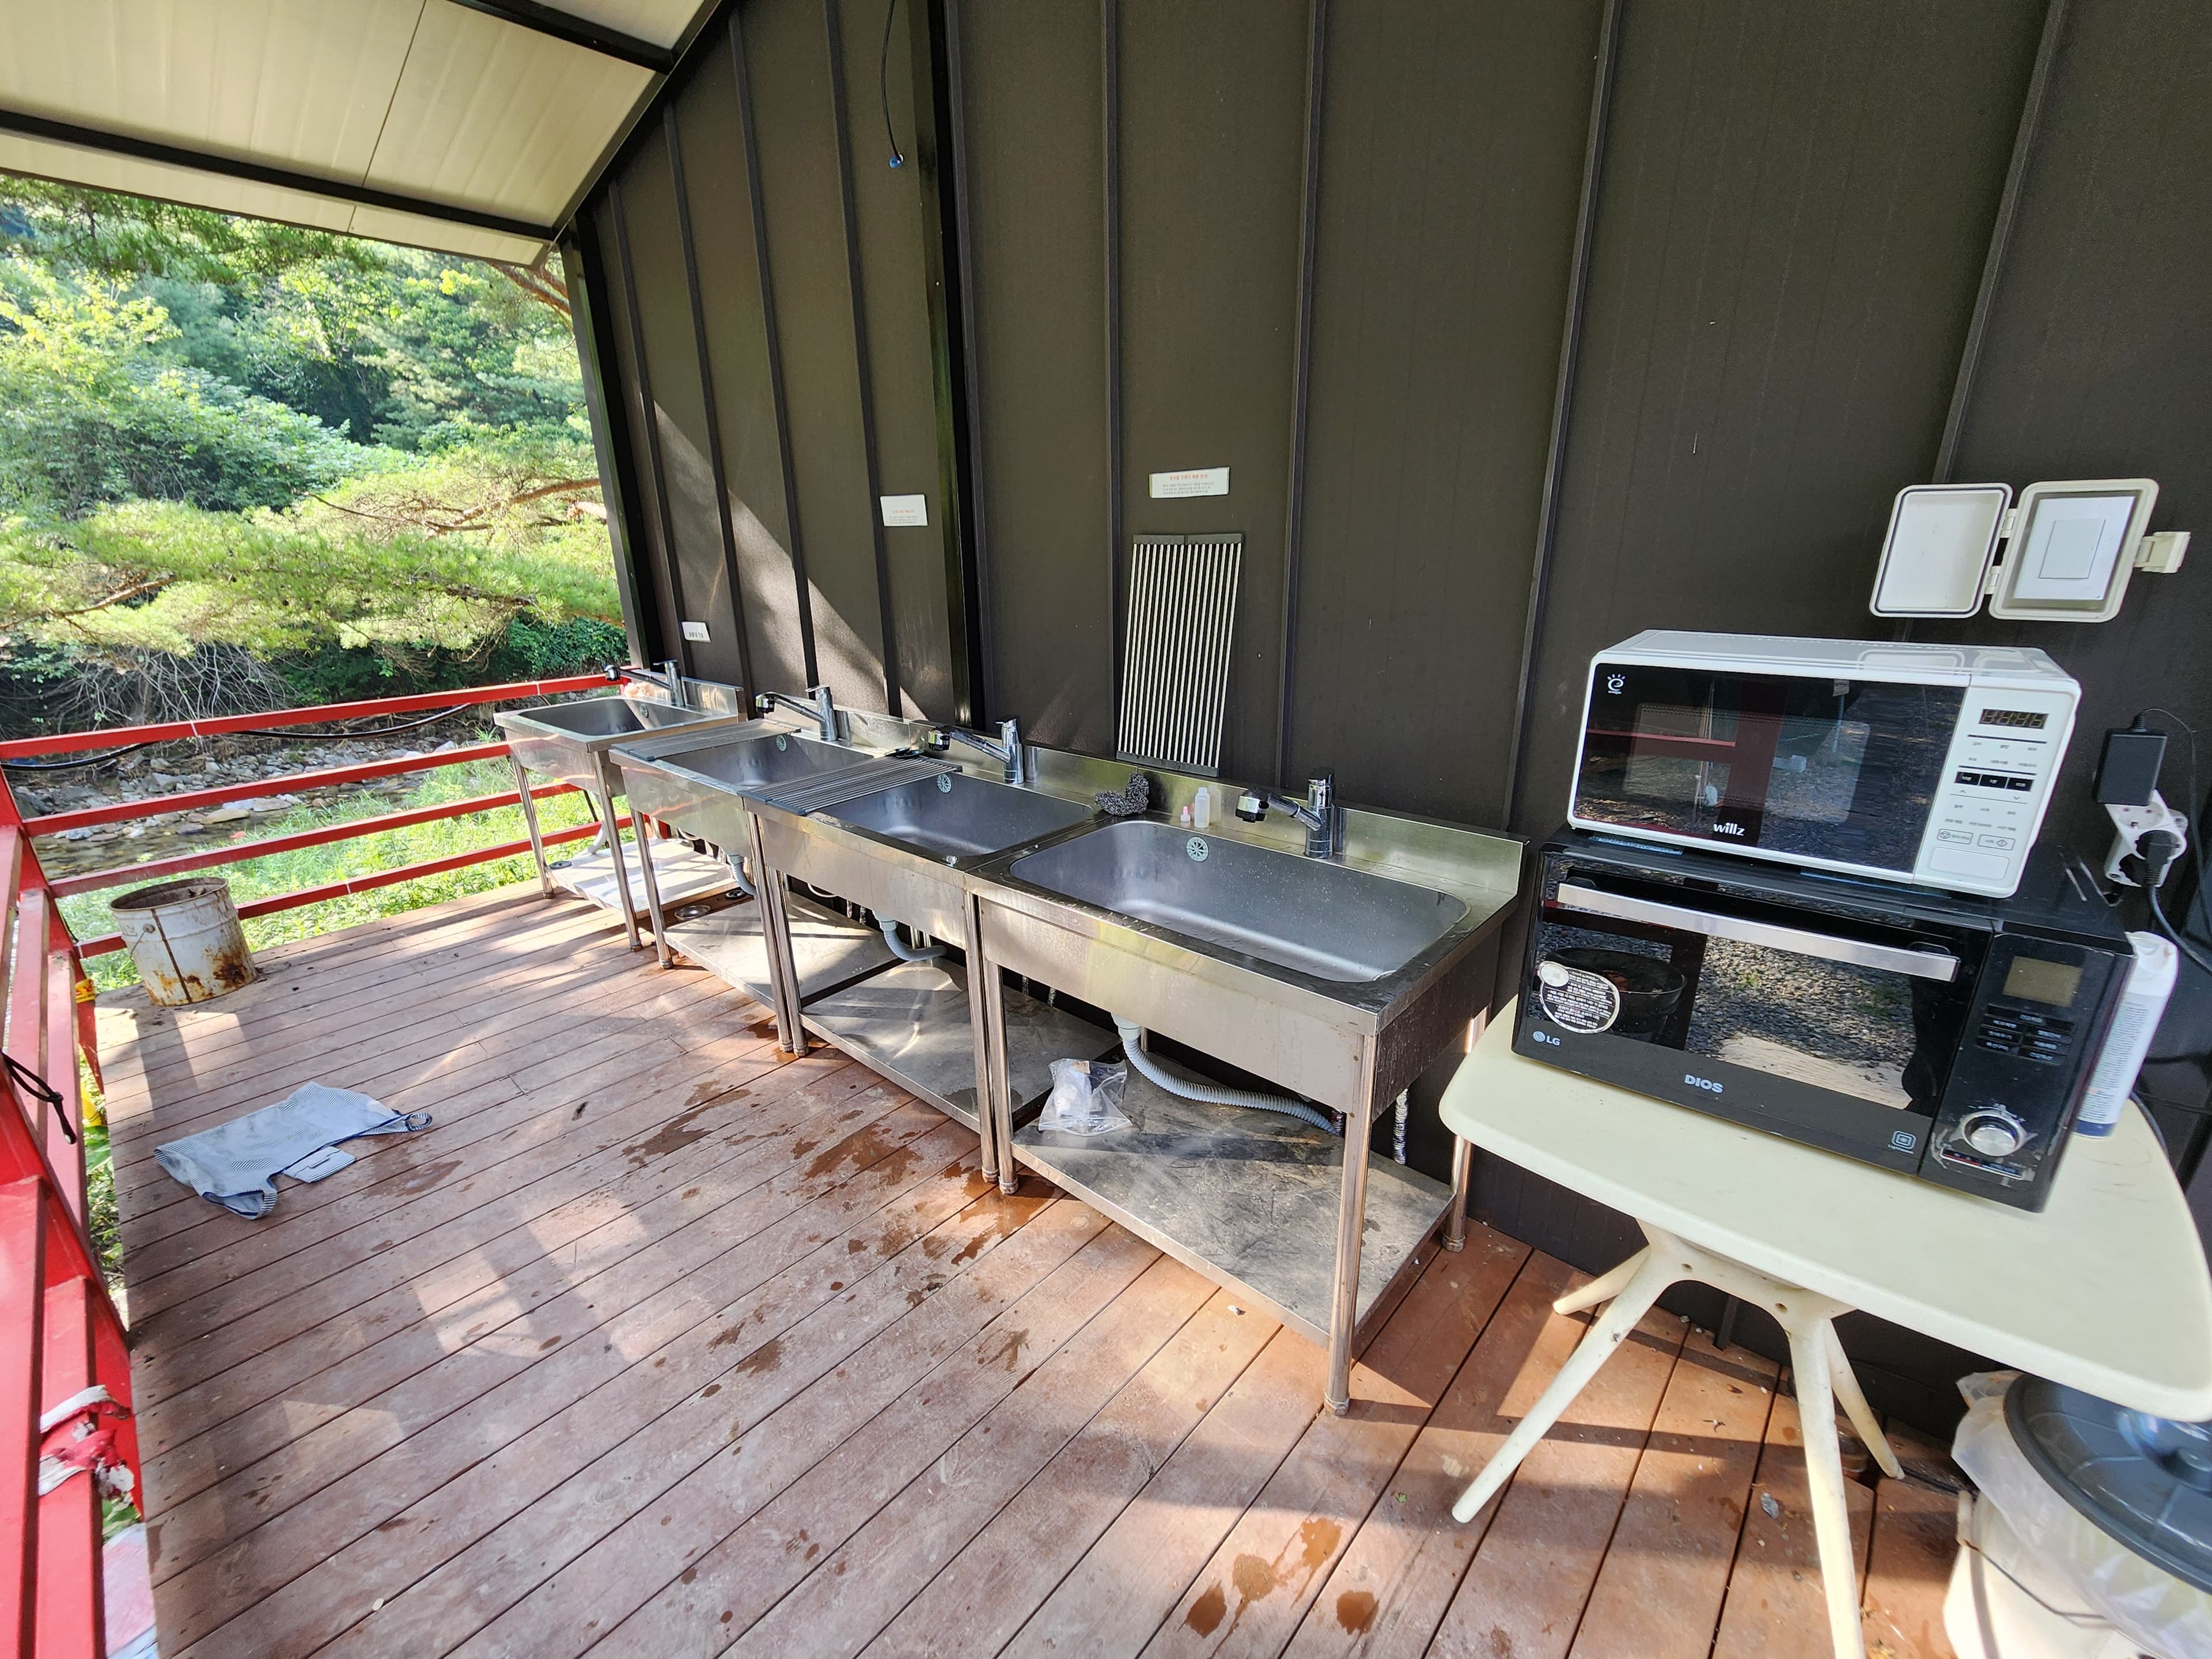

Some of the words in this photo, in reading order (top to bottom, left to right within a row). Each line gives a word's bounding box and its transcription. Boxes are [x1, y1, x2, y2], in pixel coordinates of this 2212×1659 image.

[1713, 822, 1745, 836] willz
[1546, 1035, 1561, 1046] LG
[1684, 1074, 1724, 1093] DIOS
